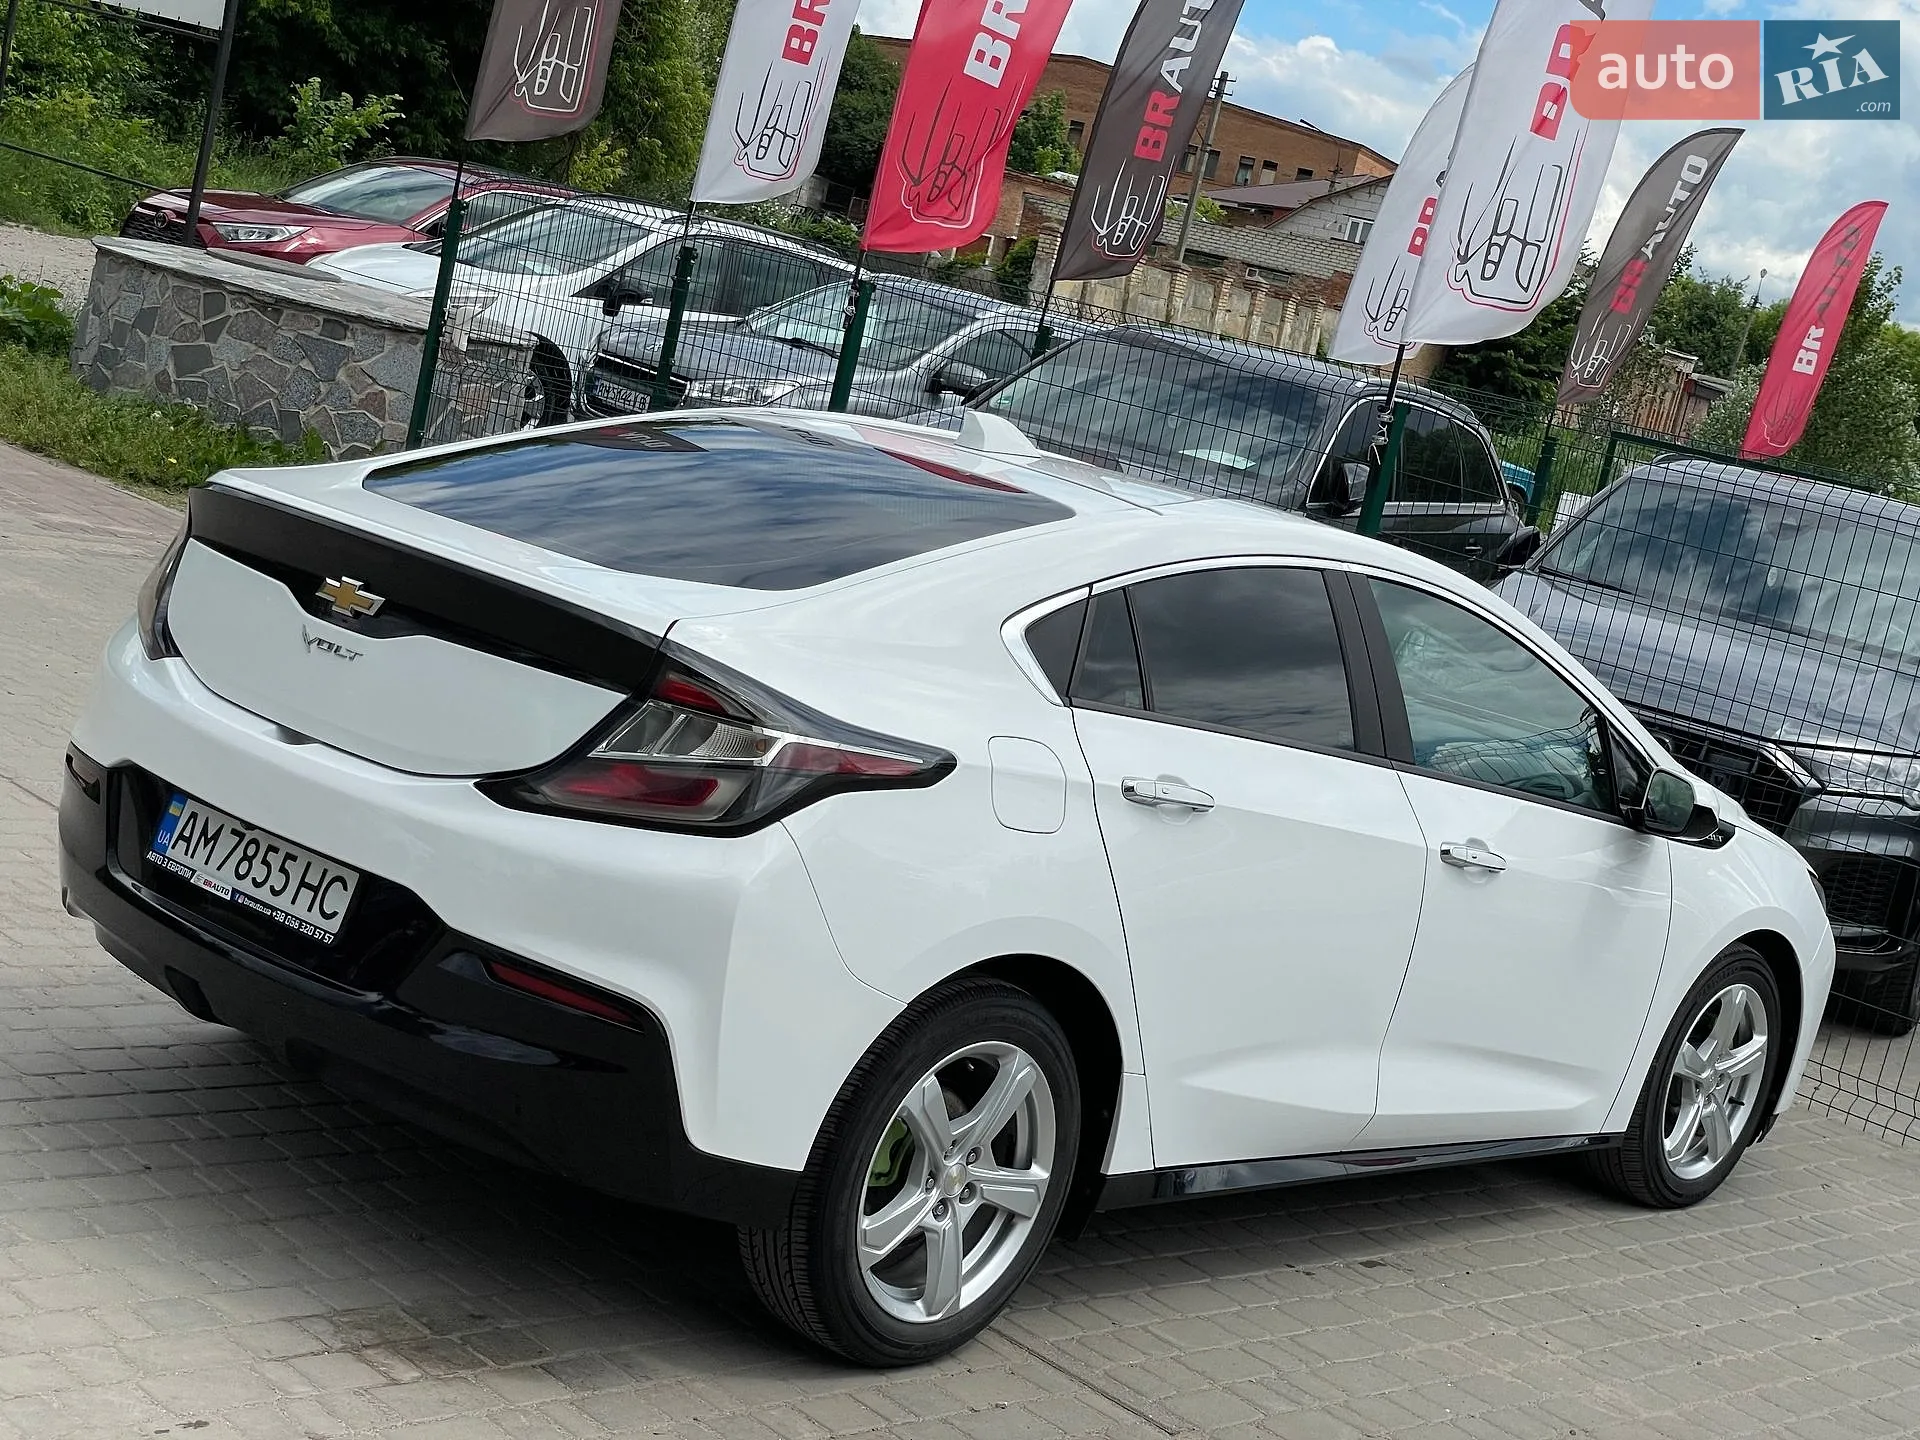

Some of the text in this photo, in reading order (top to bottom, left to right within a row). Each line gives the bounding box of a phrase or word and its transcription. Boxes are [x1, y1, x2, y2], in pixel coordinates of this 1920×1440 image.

[302, 623, 364, 662] VOLT
[157, 829, 171, 846] UA
[203, 878, 230, 896] BRAUTO
[272, 910, 286, 923] +38
[299, 922, 315, 936] 320
[313, 929, 325, 940] 57
[323, 933, 335, 945] 57
